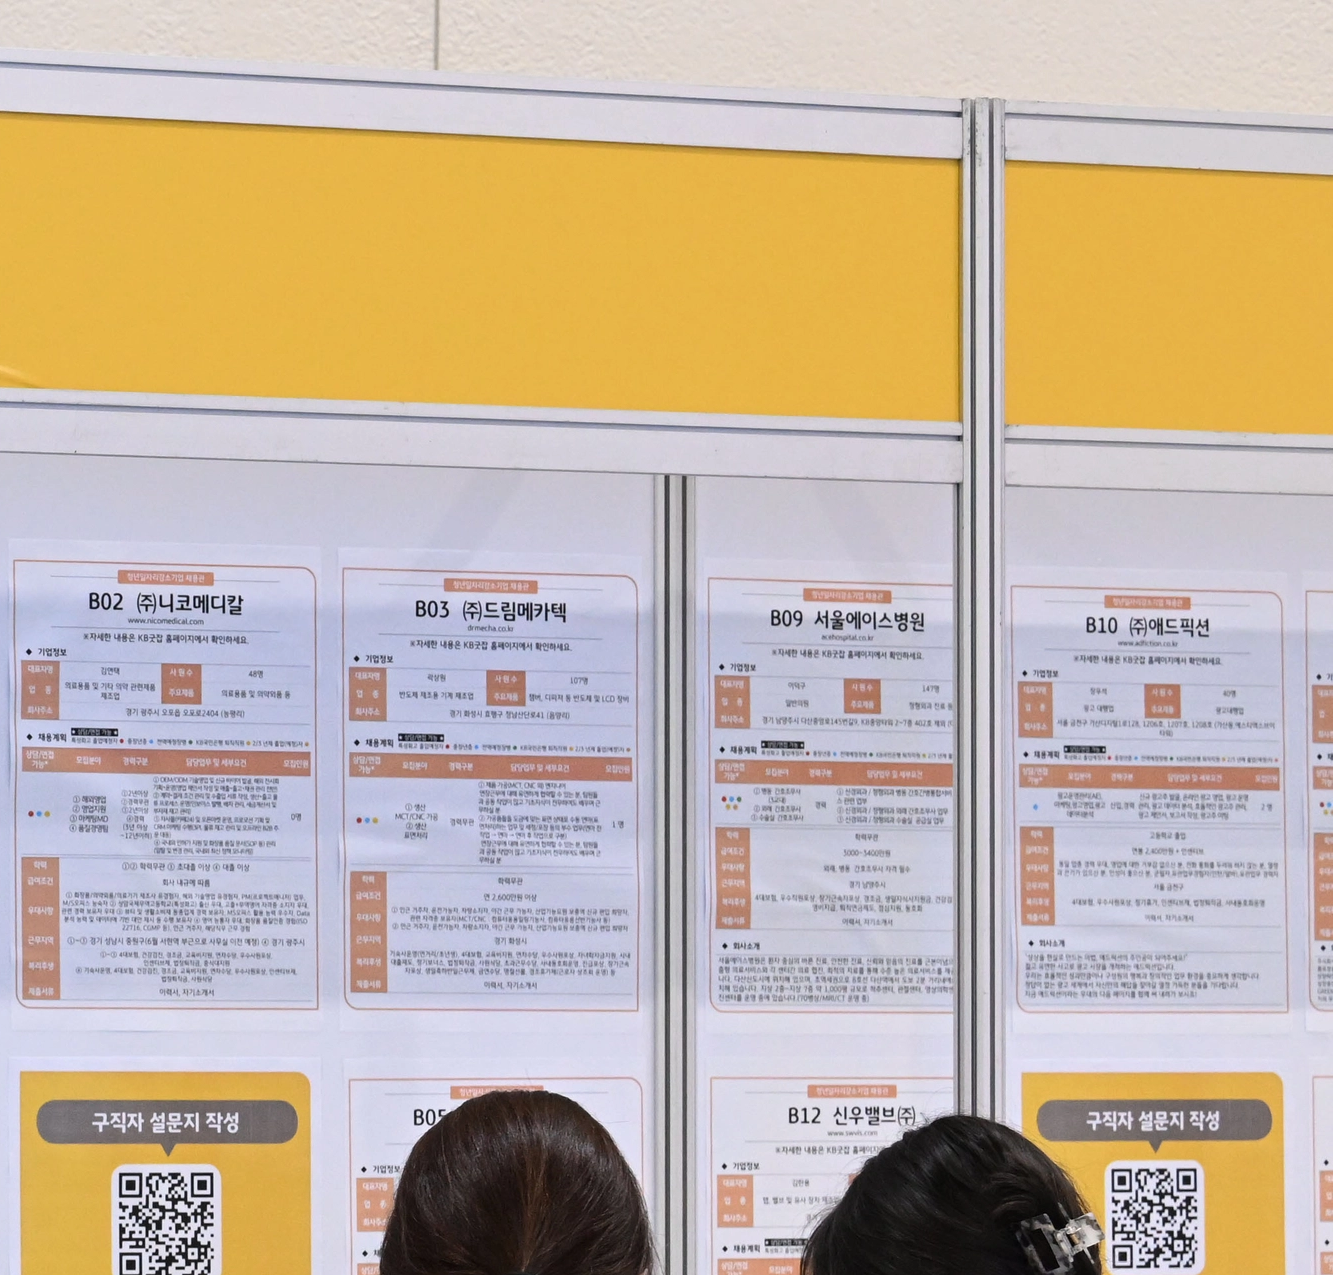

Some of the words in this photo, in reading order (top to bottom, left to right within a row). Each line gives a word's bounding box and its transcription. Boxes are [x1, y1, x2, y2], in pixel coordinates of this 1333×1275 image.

[89, 593, 123, 610] B02
[416, 600, 449, 618] B03
[127, 616, 205, 626] www.nicomedical.com
[467, 624, 514, 633] drmecha.co.kr
[771, 610, 802, 627] B09
[815, 610, 924, 632] 서울에이스병원
[1086, 617, 1117, 634] B10
[92, 1112, 144, 1133] 구직자
[150, 1113, 199, 1133] 설문지
[206, 1112, 238, 1133] 작성
[789, 1107, 820, 1124] B12
[1087, 1111, 1133, 1131] 구직자
[1139, 1111, 1184, 1131] 설문지
[1190, 1111, 1219, 1131] 작성
